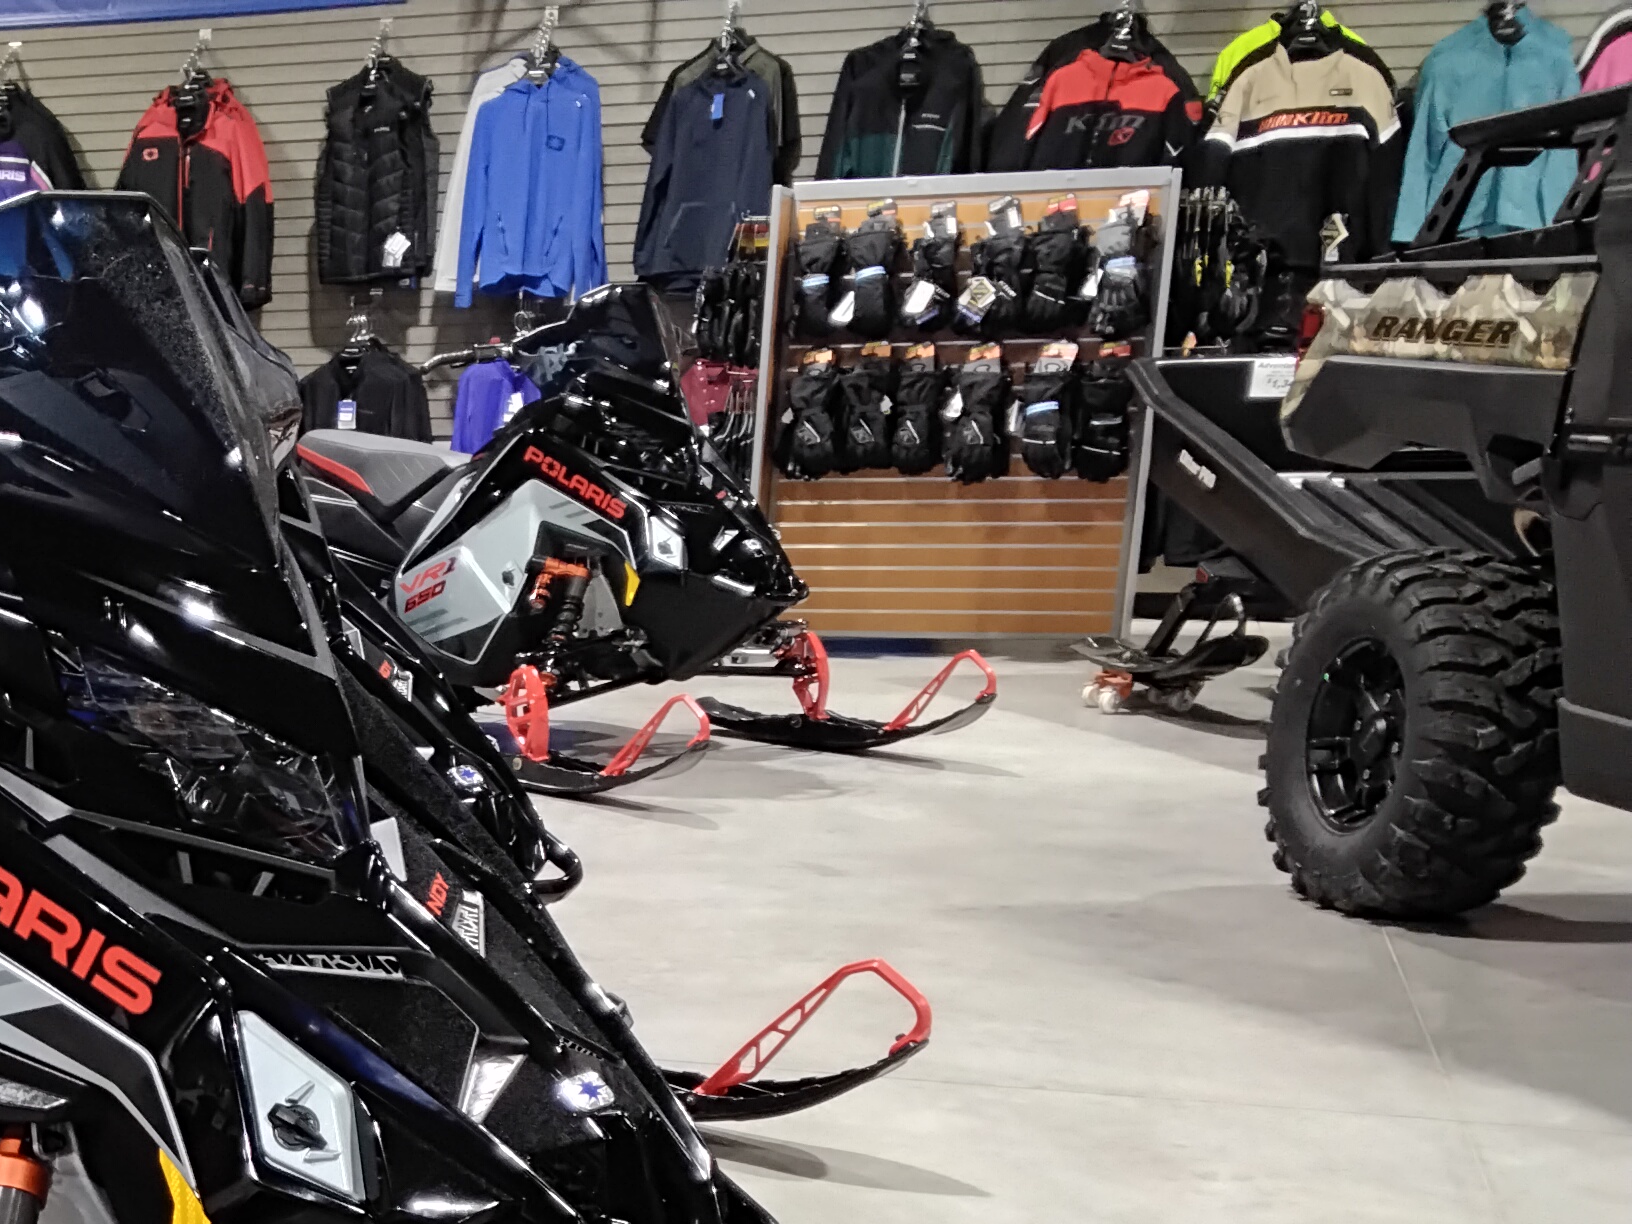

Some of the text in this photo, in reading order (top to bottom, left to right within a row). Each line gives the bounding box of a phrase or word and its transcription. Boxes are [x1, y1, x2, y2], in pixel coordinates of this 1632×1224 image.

[1369, 316, 1519, 347] RANGER
[523, 445, 627, 519] POLARIS
[400, 556, 457, 594] VR1
